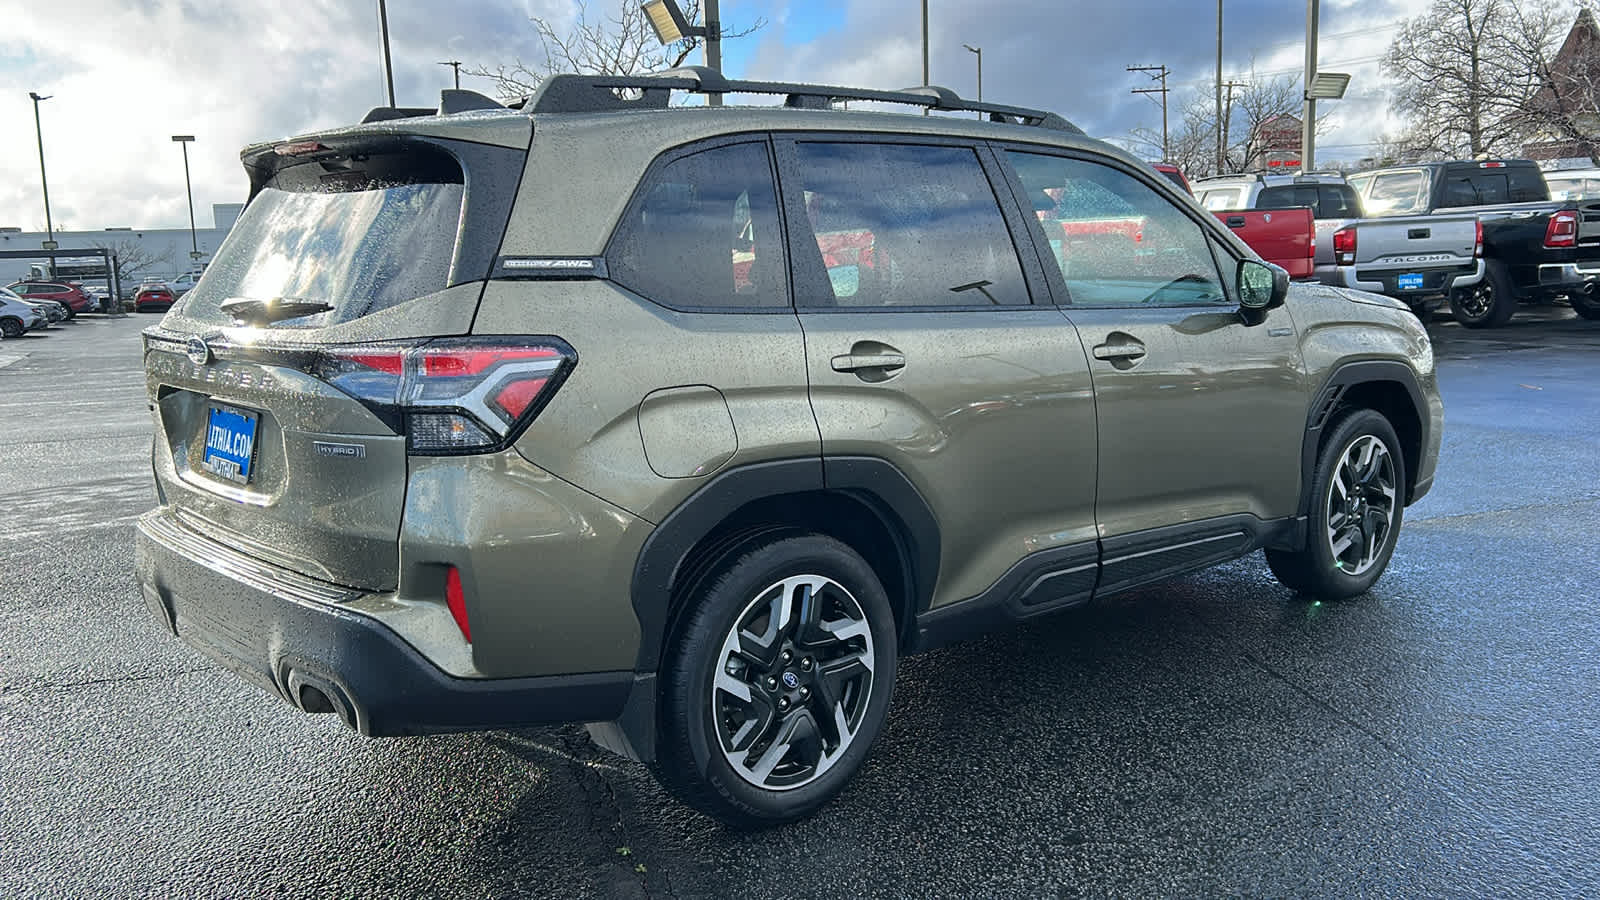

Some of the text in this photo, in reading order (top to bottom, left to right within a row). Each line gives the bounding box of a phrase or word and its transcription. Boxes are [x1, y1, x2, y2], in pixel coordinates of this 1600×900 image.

[1383, 254, 1450, 263] TACOMA
[551, 260, 593, 268] AWD
[321, 445, 355, 455] HYBRID
